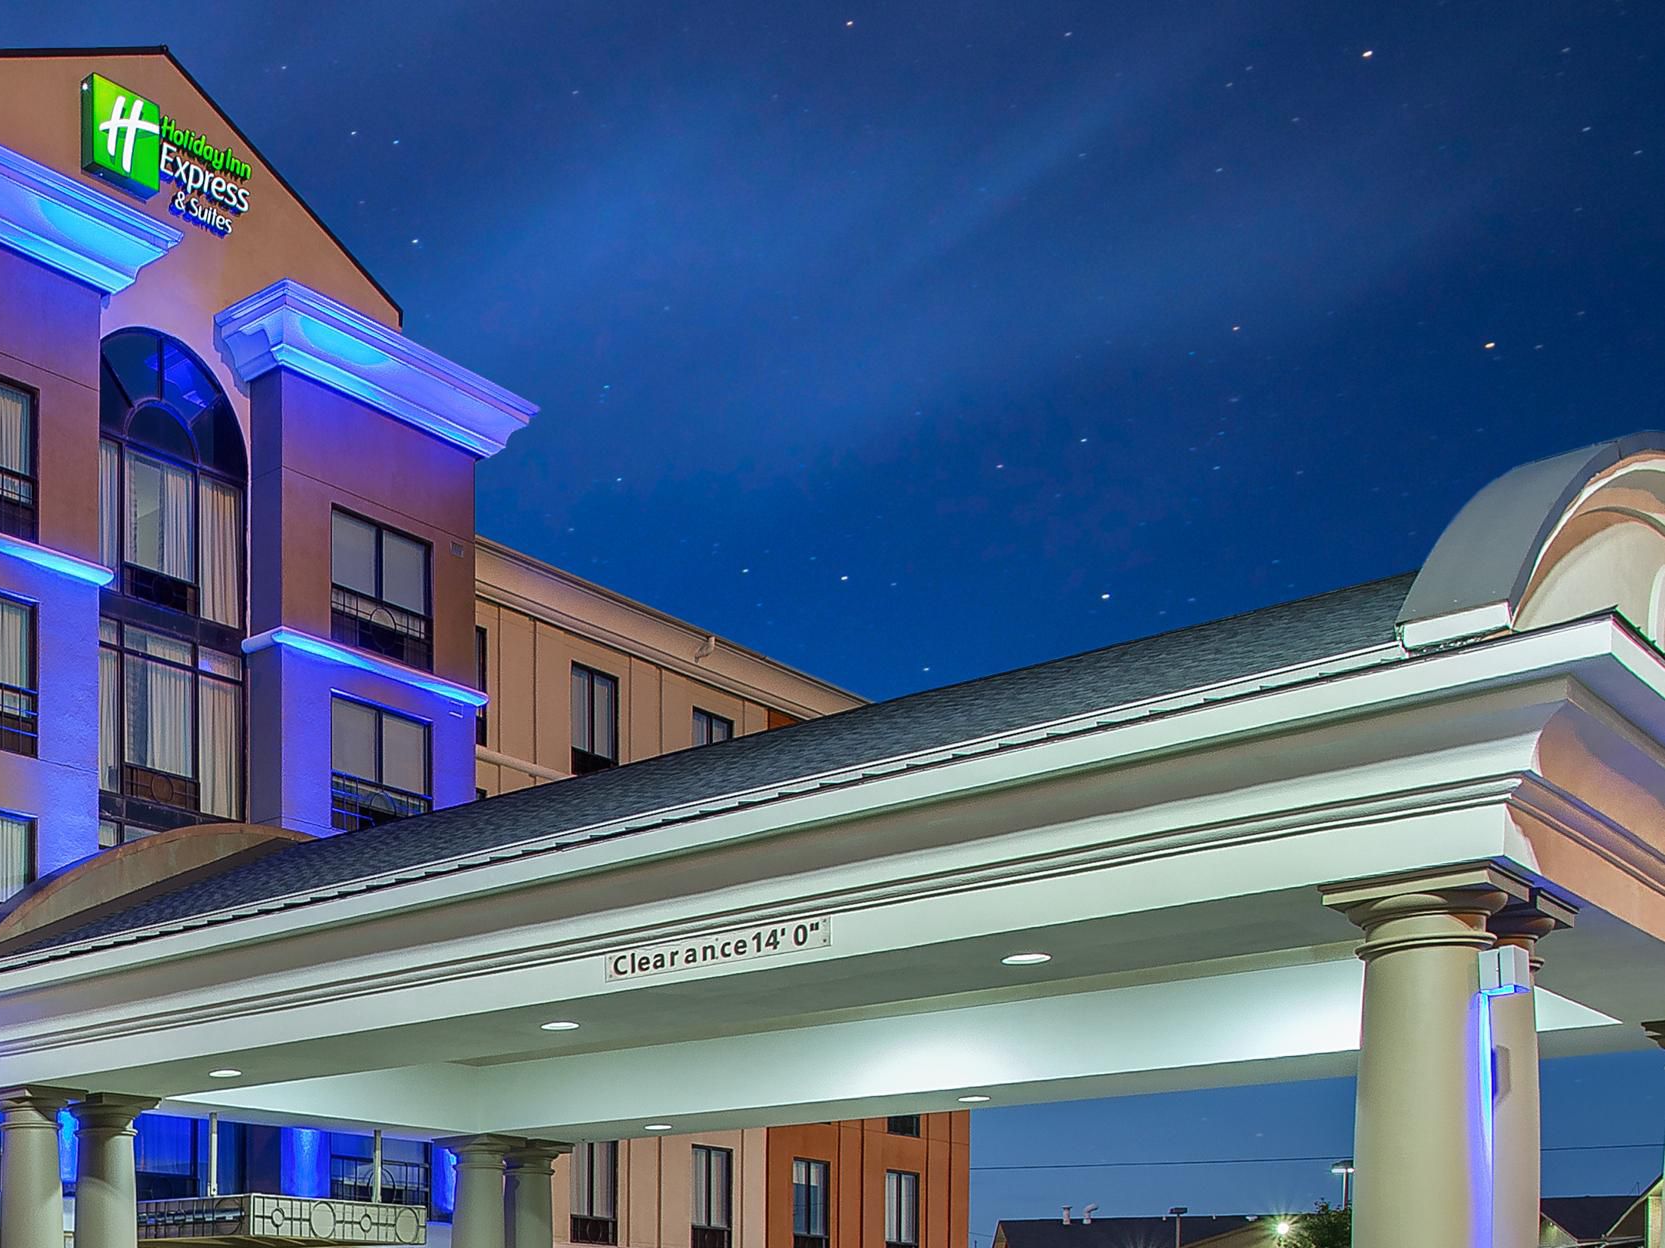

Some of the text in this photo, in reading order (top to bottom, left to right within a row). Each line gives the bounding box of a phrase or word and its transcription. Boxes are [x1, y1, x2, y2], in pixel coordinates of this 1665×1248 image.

[161, 116, 251, 180] Holiday Inn
[159, 142, 250, 212] Express
[174, 191, 232, 234] & Suites
[613, 938, 747, 975] Clearance
